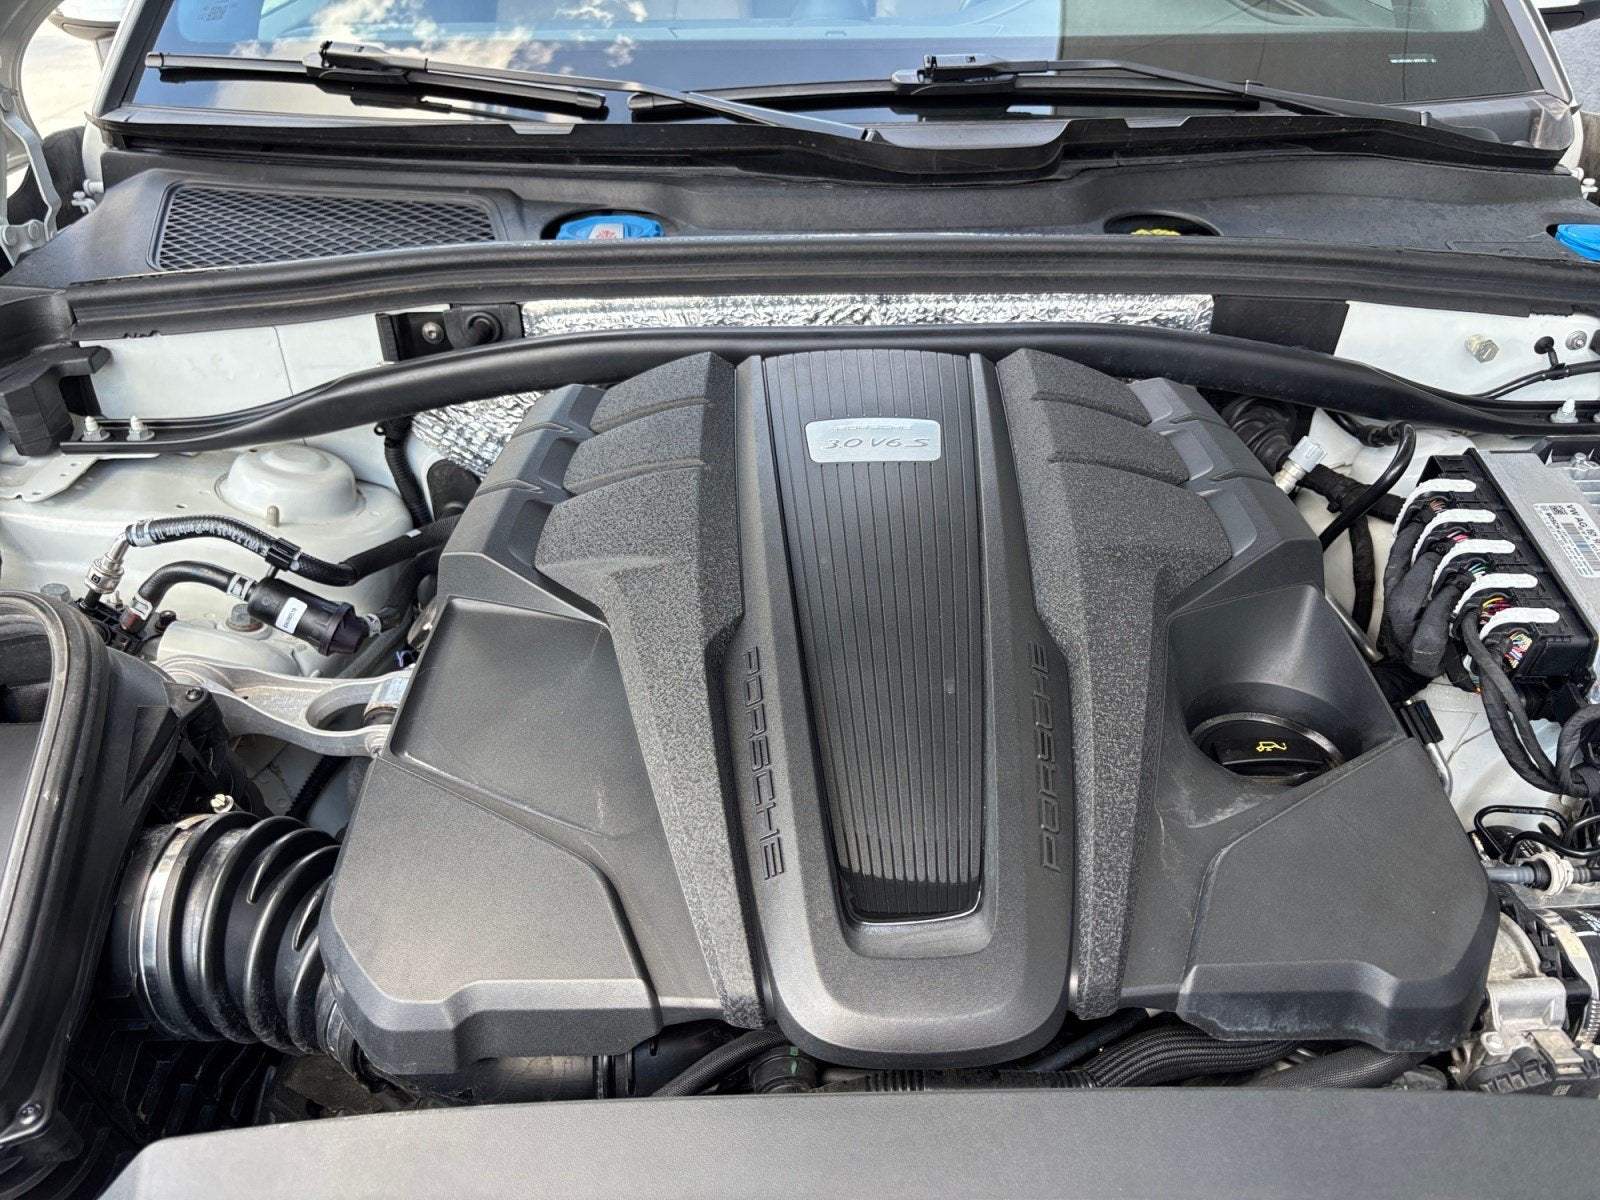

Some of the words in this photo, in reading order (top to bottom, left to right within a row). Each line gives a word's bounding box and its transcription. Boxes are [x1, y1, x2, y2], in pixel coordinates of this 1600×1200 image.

[822, 438, 863, 449] 3.0
[871, 438, 901, 448] V6
[905, 438, 931, 448] S
[1567, 504, 1580, 516] VW
[1575, 517, 1588, 528] AG
[743, 645, 785, 881] PORSCHE
[1028, 640, 1061, 873] PORSCHE
